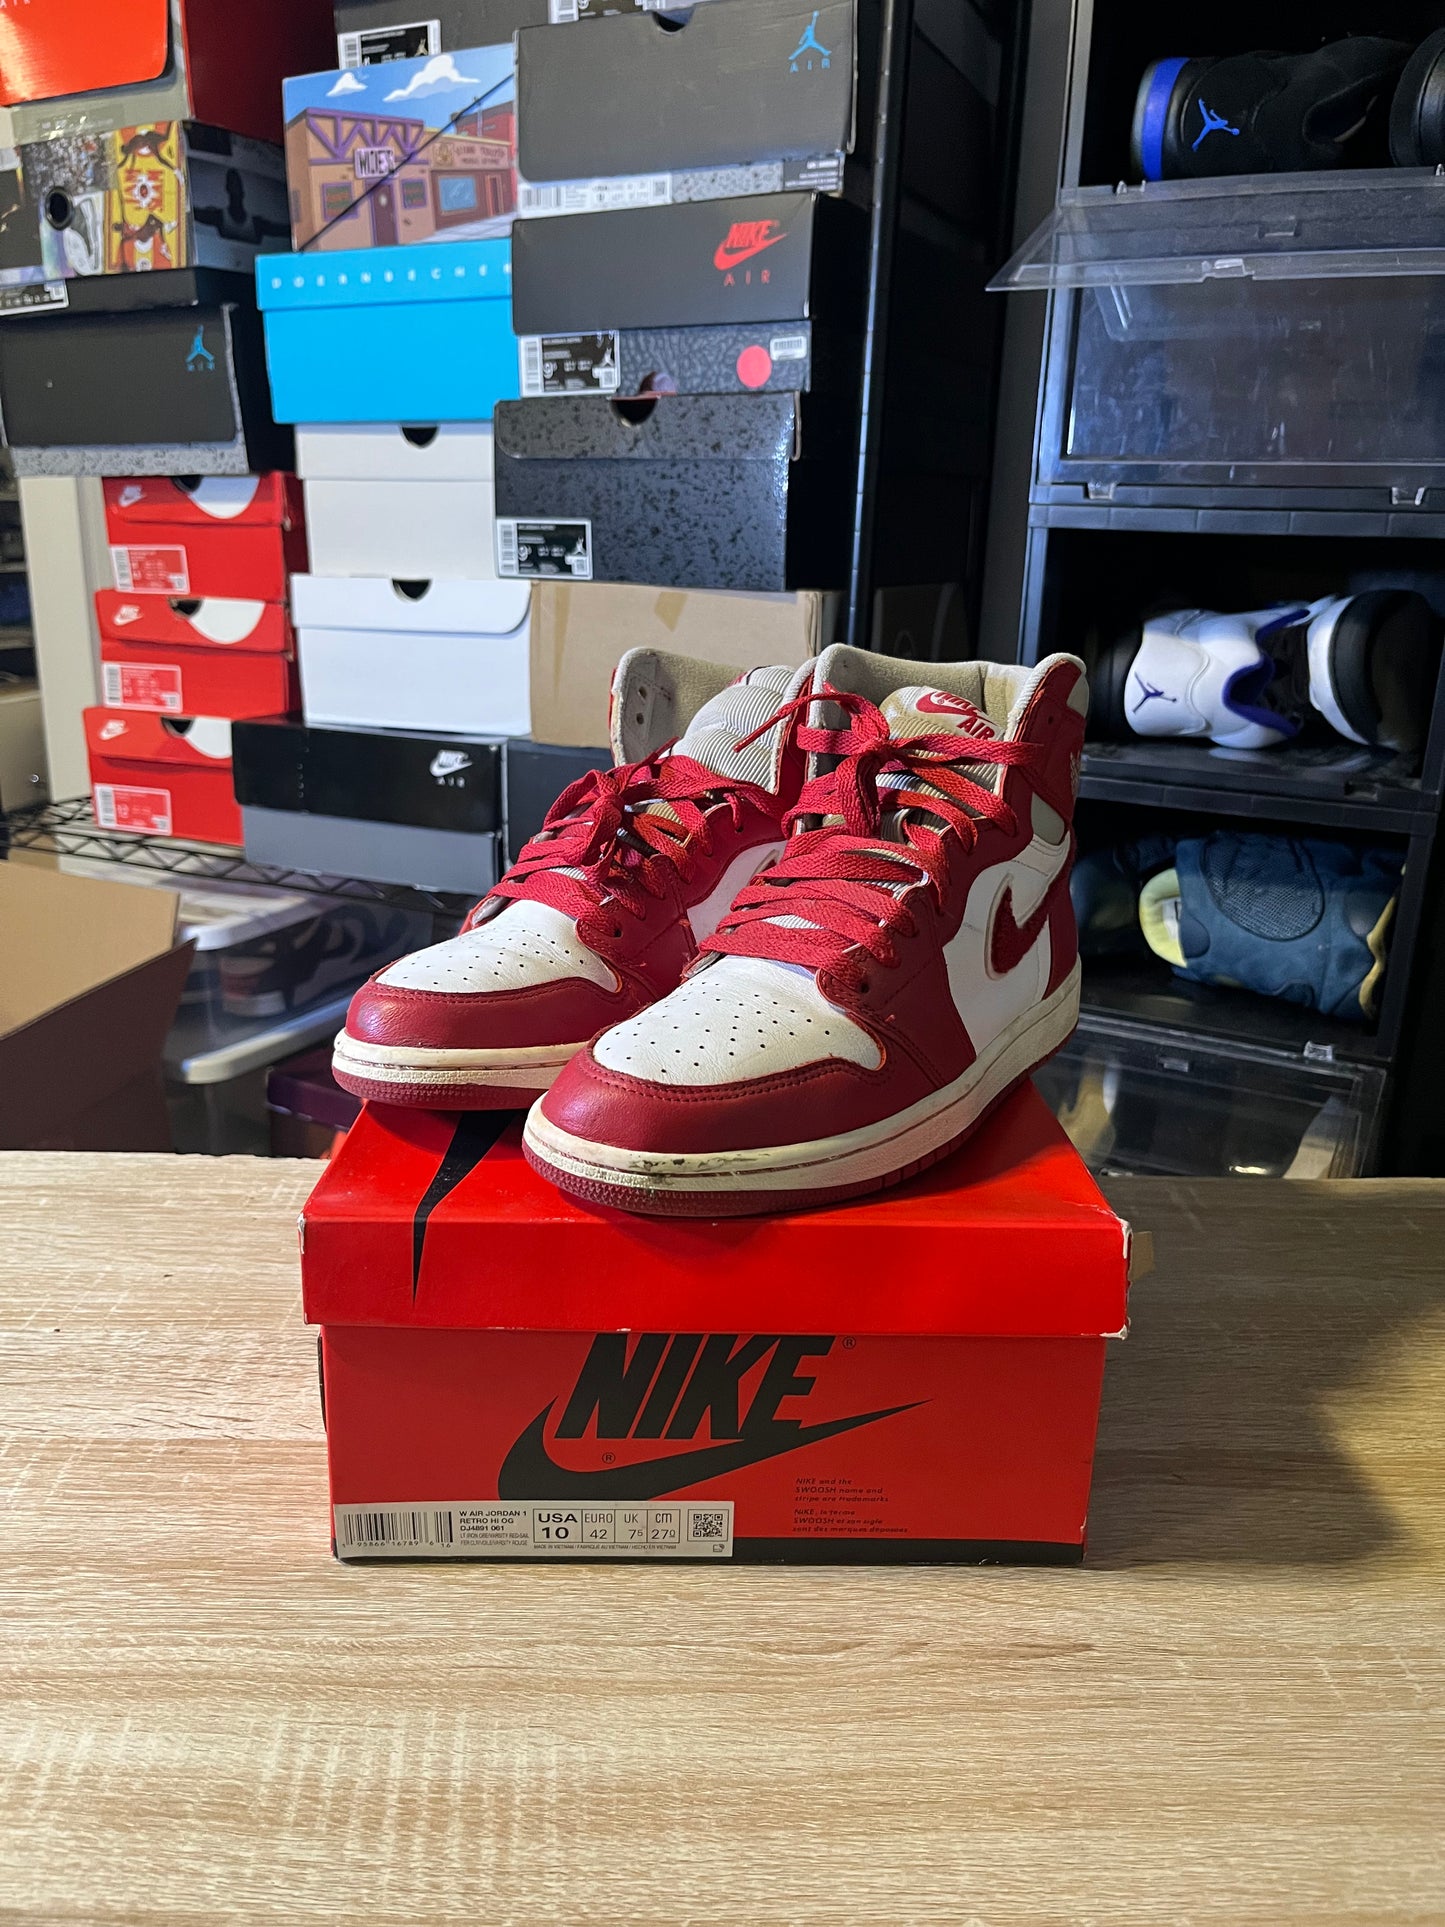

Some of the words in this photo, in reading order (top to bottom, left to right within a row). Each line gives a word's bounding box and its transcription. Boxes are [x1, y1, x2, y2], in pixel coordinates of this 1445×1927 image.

[789, 57, 831, 73] AIR
[725, 219, 774, 248] NIKE
[723, 269, 771, 287] AIR
[956, 716, 995, 741] AIR
[554, 1333, 837, 1440] NIKE
[795, 1486, 836, 1494] SWOOSH
[538, 1513, 578, 1523] USA
[584, 1513, 613, 1524] EURO
[624, 1513, 639, 1524] UK
[541, 1527, 570, 1539] 10
[589, 1529, 607, 1540] 42
